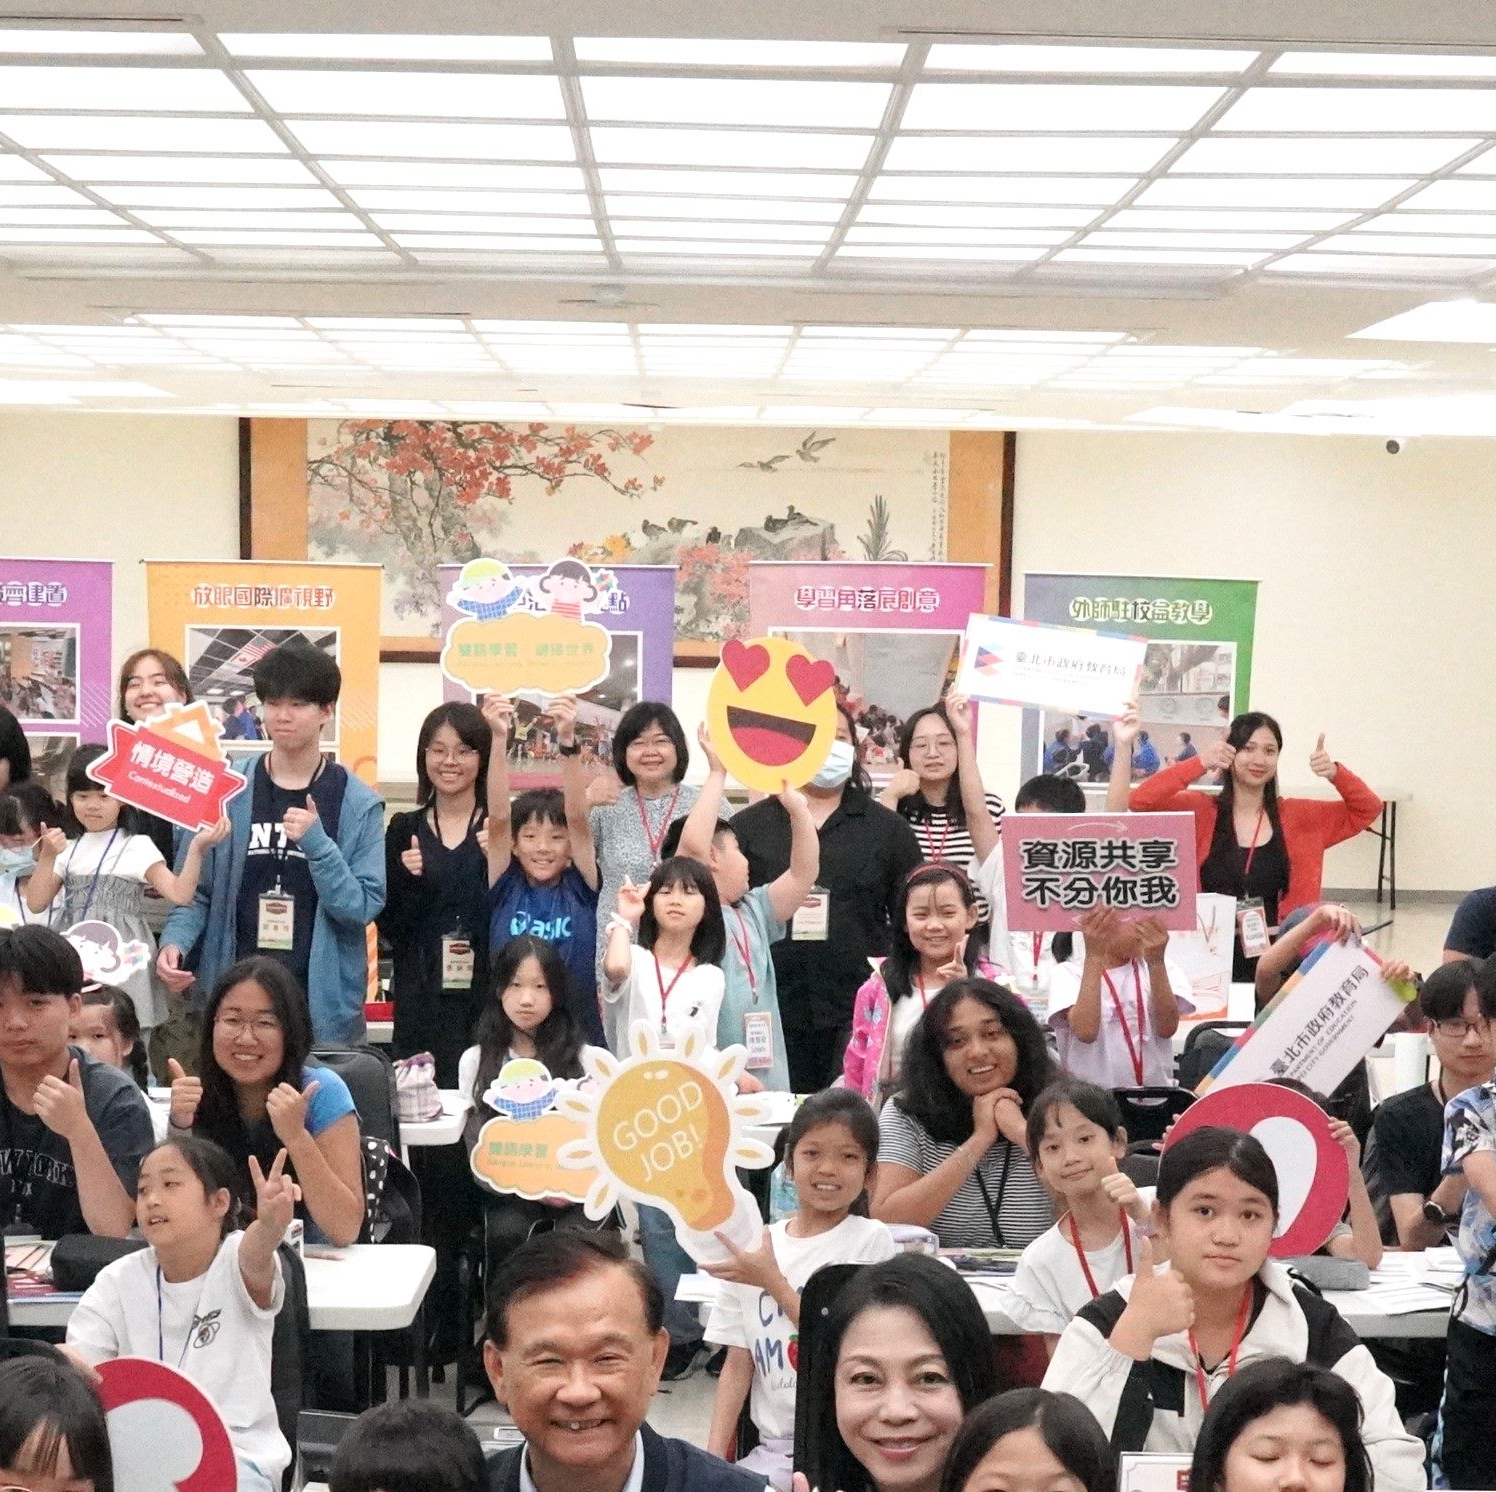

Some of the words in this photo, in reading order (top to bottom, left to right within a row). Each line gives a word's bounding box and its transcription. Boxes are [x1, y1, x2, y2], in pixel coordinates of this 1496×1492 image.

[129, 739, 216, 796] 情境營造
[248, 822, 288, 849] NT
[1022, 839, 1177, 871] 資源共享
[1024, 876, 1178, 906] 不分你我
[1269, 964, 1370, 1078] 臺北市政府教育局
[1287, 1045, 1319, 1077] PARTMENT
[612, 1080, 703, 1152] GOOD
[638, 1122, 704, 1182] JOB!
